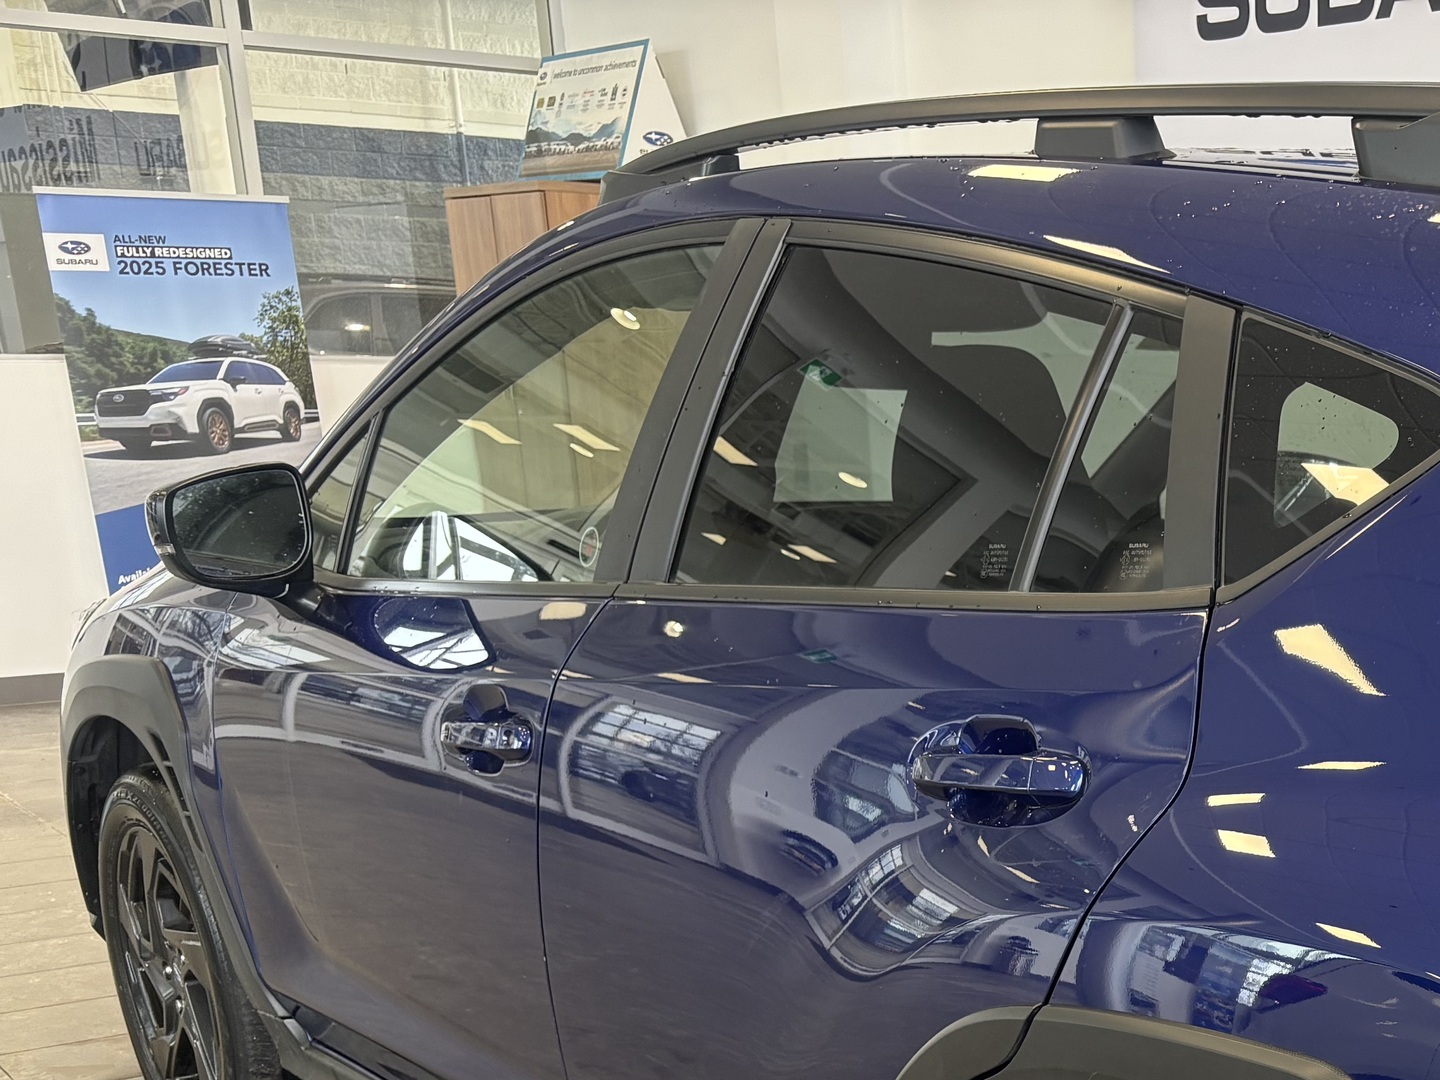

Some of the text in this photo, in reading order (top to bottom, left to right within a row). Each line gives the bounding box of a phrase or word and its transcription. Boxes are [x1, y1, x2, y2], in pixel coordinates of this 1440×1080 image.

[113, 234, 166, 245] ALL-NEW
[116, 246, 231, 259] FULLY REDESIGNED
[56, 258, 98, 266] SUBARU
[117, 260, 271, 277] 2025 FORESTER
